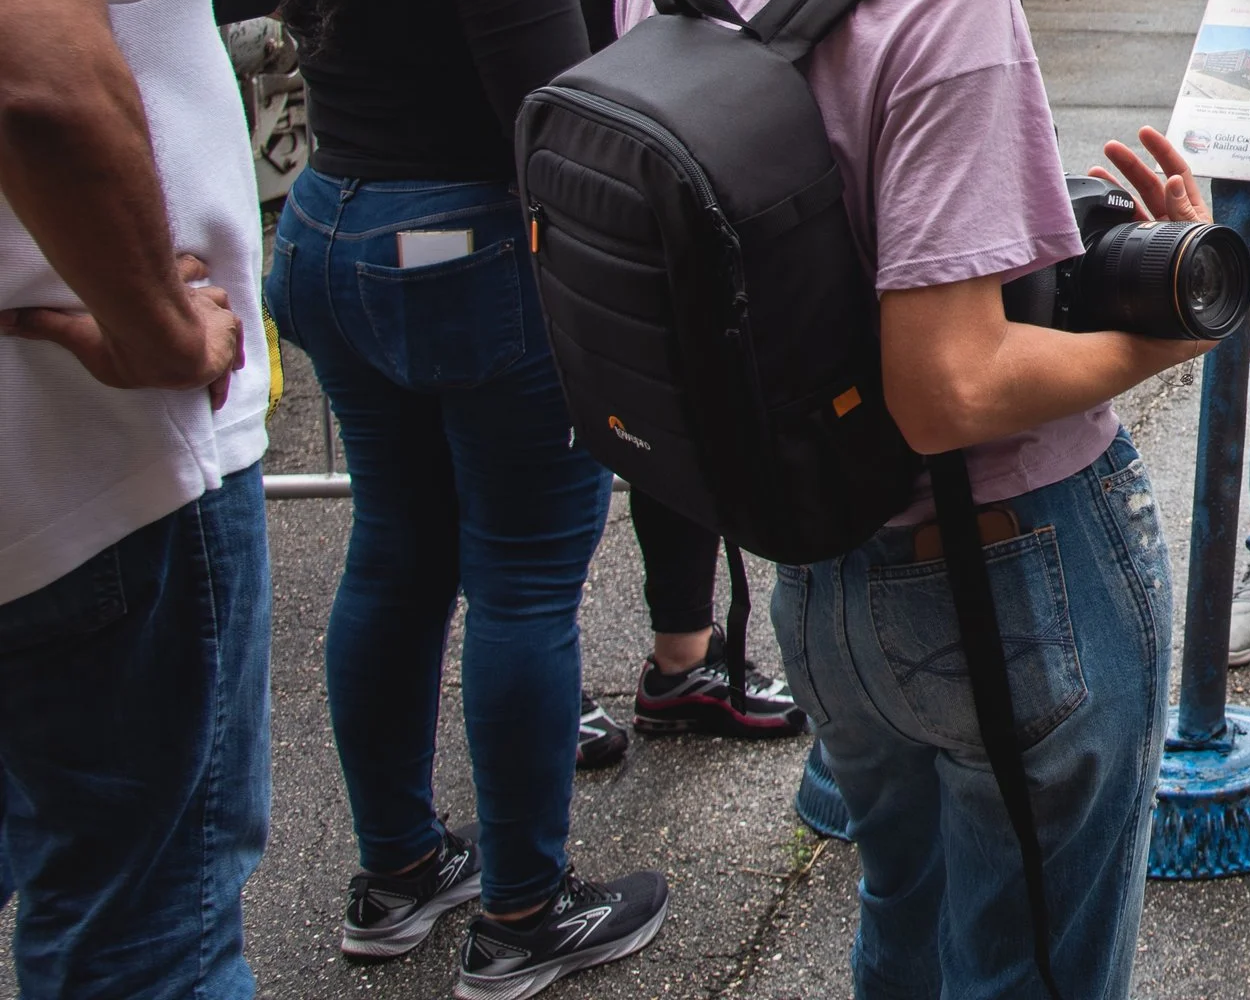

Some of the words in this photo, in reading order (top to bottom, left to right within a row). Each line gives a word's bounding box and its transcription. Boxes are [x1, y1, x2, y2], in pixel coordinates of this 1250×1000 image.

[1215, 133, 1236, 142] Gold
[1213, 141, 1248, 152] Railroad
[1108, 194, 1134, 208] Nikon
